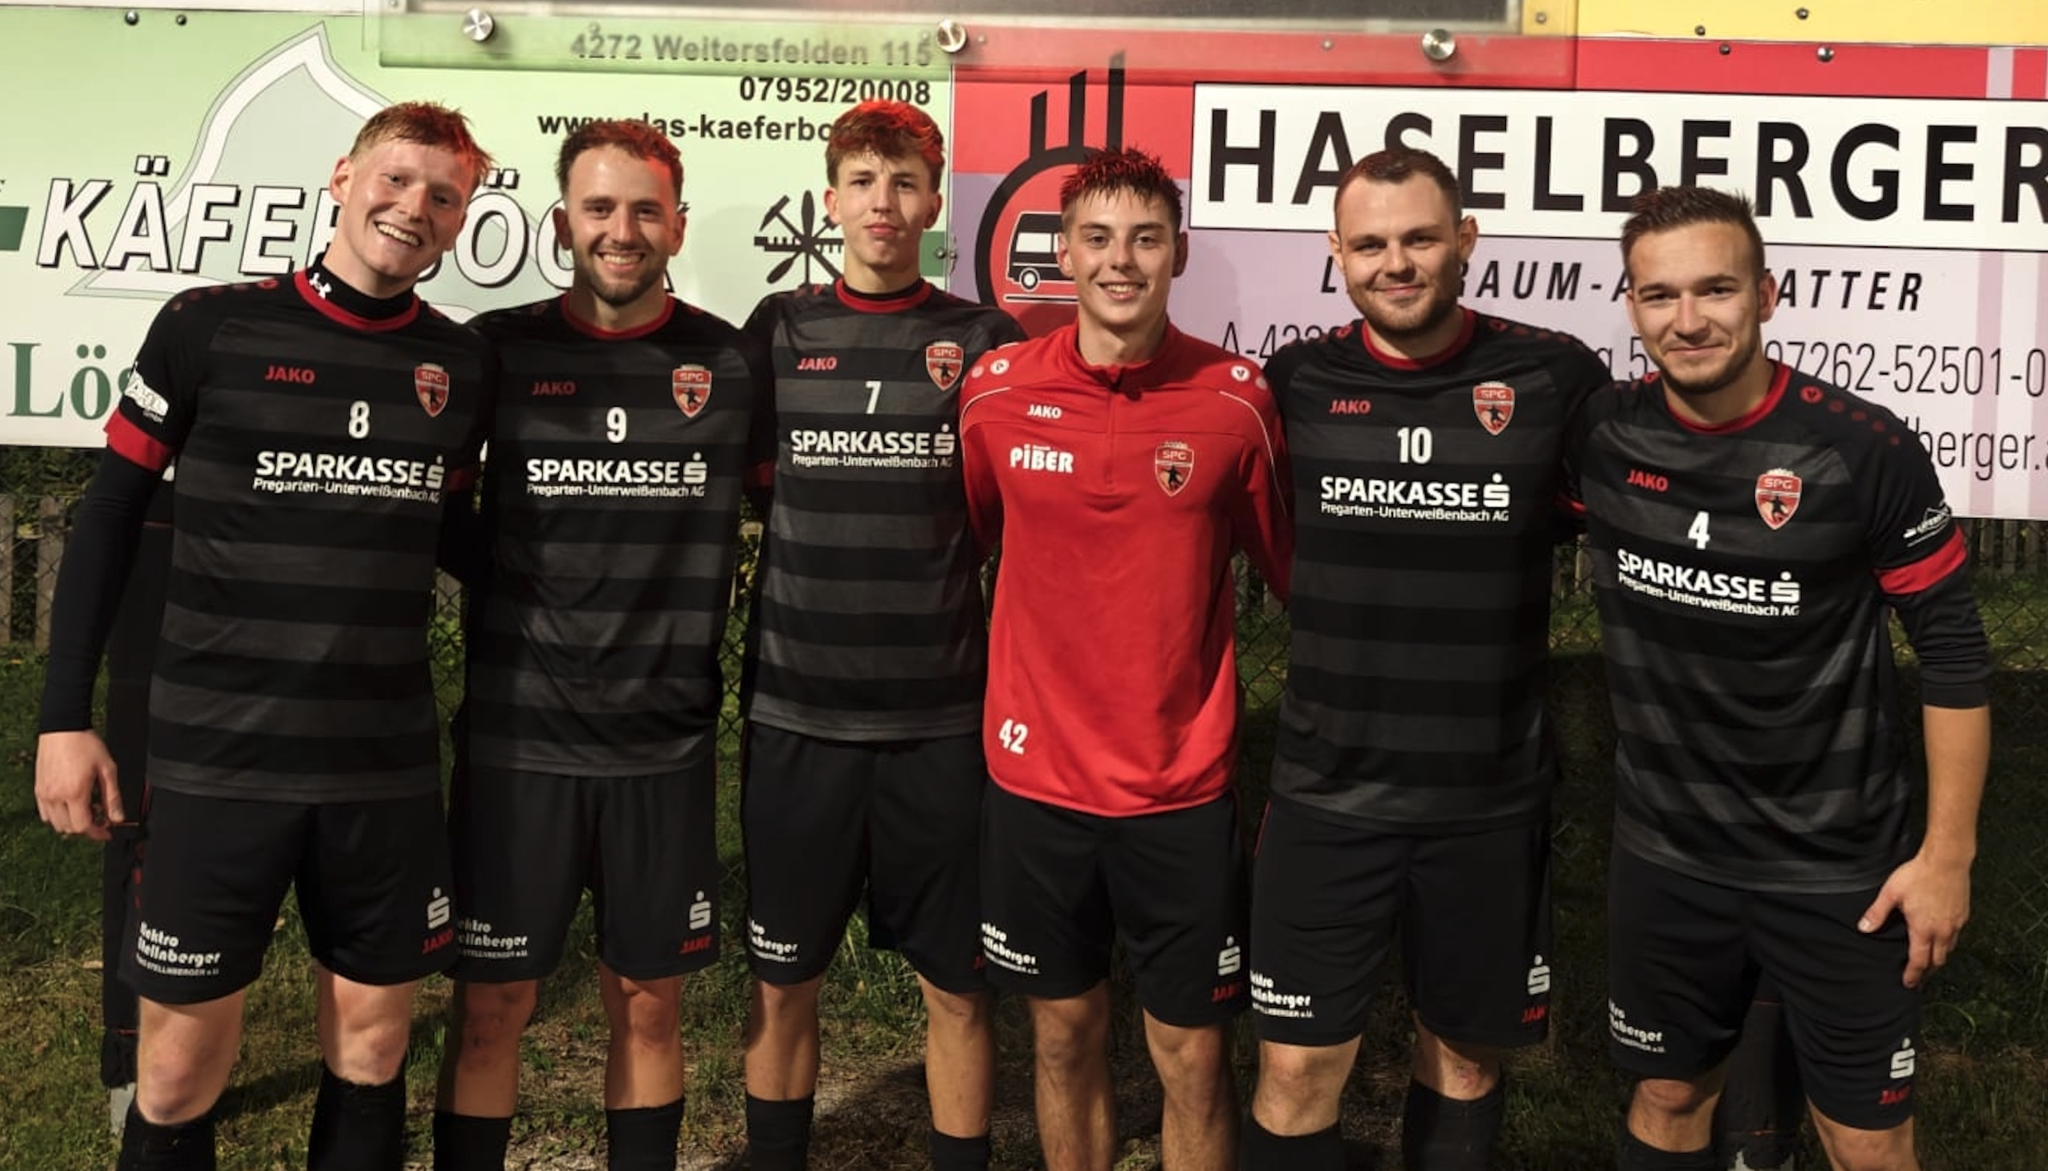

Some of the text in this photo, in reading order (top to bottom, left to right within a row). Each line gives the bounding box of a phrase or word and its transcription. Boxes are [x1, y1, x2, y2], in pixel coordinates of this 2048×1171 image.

[570, 32, 932, 67] 4272 Weitersfelden 115
[739, 75, 931, 104] 07952/20008
[265, 366, 316, 384] JAKO
[797, 357, 838, 371] JAKO
[6, 342, 133, 420] Lö
[532, 381, 576, 396] JAKO
[865, 380, 882, 415] 7
[1027, 404, 1063, 419] JAKO
[1329, 400, 1371, 414] JAKO
[348, 401, 370, 439] 8
[606, 407, 628, 443] 9
[790, 430, 931, 455] SPARKASSE
[1397, 427, 1432, 464] 10
[256, 451, 425, 486] SPARKASSE
[526, 458, 680, 483] SPARKASSE
[1627, 469, 1668, 492] JAKO
[1764, 477, 1792, 490] SPG
[1321, 476, 1478, 507] SPARKASSE
[1687, 511, 1710, 549] 4
[1617, 548, 1766, 601] SPARKASSE
[998, 718, 1028, 756] 42
